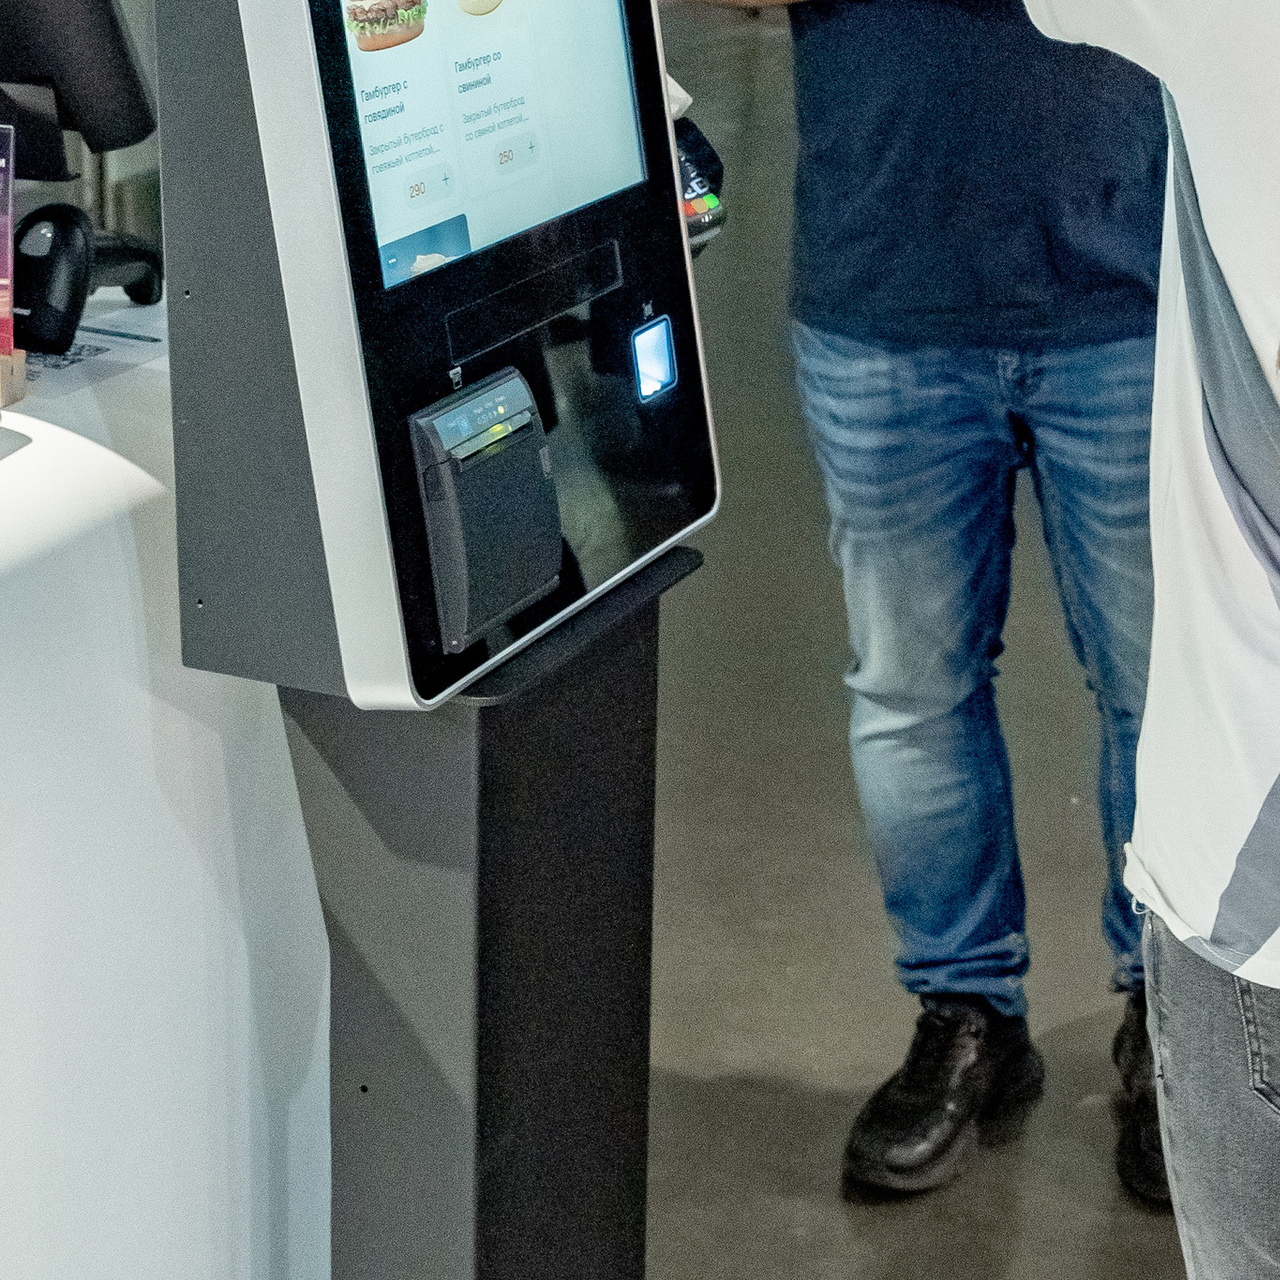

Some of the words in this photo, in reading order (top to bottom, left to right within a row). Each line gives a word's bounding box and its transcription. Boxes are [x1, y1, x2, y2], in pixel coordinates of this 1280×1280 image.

[454, 54, 491, 74] Гамбургер
[492, 51, 502, 62] со
[361, 82, 401, 102] Гамбургер
[402, 80, 408, 90] с
[458, 74, 492, 94] свининой
[364, 102, 405, 124] говядиной
[462, 105, 492, 124] Закрытый
[493, 96, 526, 114] бутерброд
[369, 136, 402, 156] Закрытый
[403, 126, 438, 146] бутерброд
[440, 124, 444, 132] с
[465, 132, 474, 142] со
[372, 155, 403, 174] говяжьей
[498, 150, 514, 165] 250
[410, 182, 426, 198] 290
